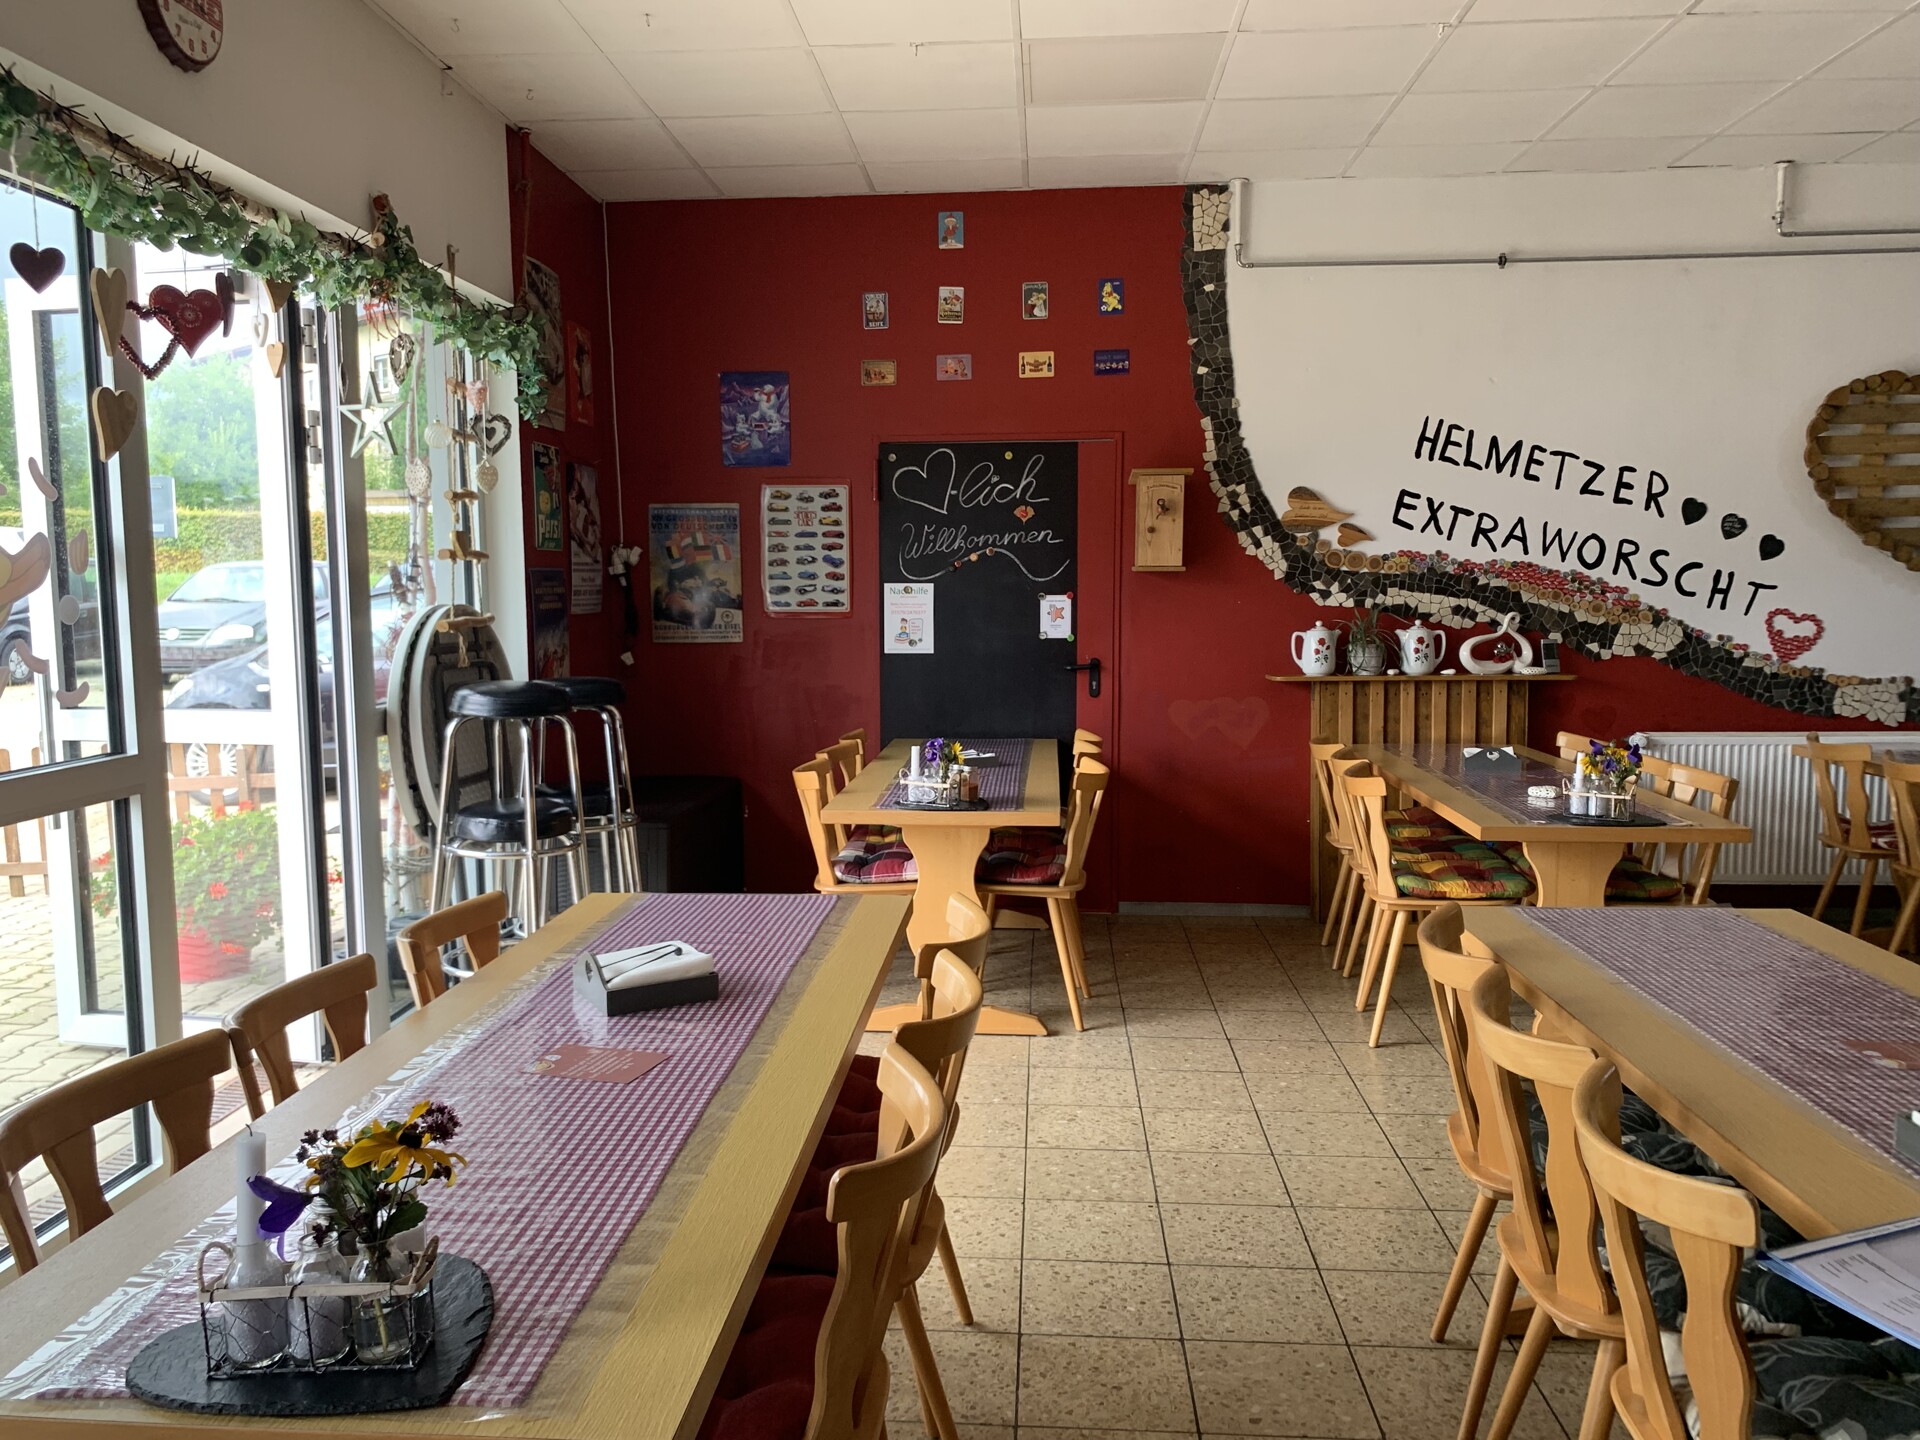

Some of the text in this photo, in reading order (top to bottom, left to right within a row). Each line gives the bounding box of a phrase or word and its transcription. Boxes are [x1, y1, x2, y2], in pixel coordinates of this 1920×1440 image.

[1414, 415, 1670, 519] HELMETZER
[651, 522, 669, 530] VON
[900, 522, 1064, 560] Willkommen
[1391, 488, 1779, 616] EXTRAWORSCHT
